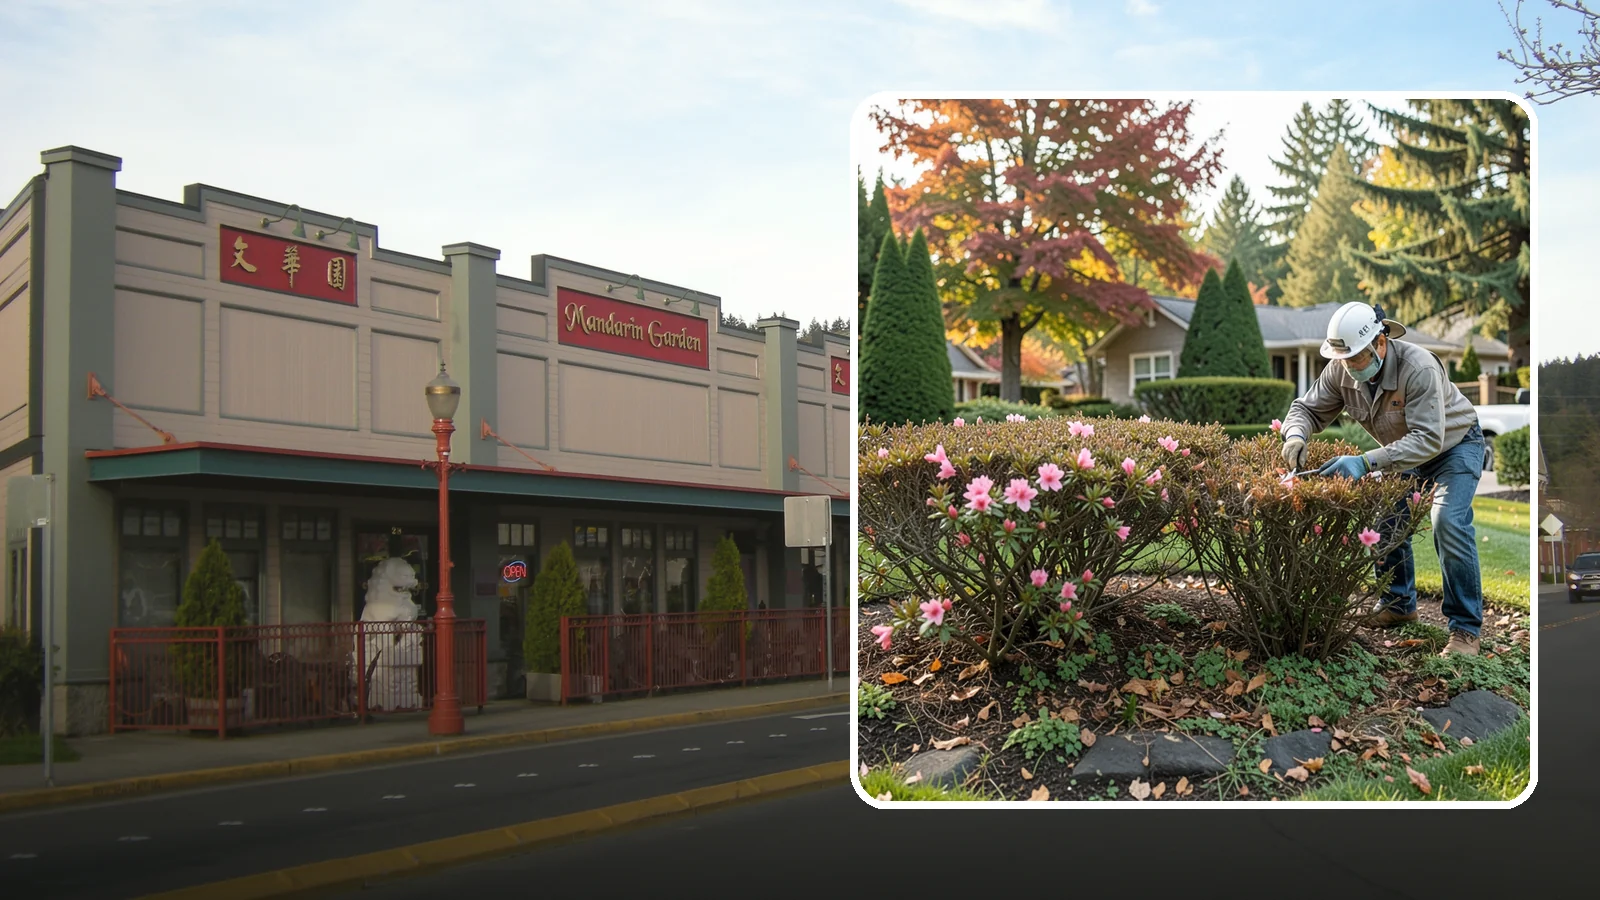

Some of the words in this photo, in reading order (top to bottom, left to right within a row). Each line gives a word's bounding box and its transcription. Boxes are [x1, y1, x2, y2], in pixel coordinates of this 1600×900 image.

[230, 236, 346, 291] 文華園
[564, 302, 644, 341] Mandarin
[648, 320, 701, 352] Garden
[503, 565, 526, 578] OPEN
